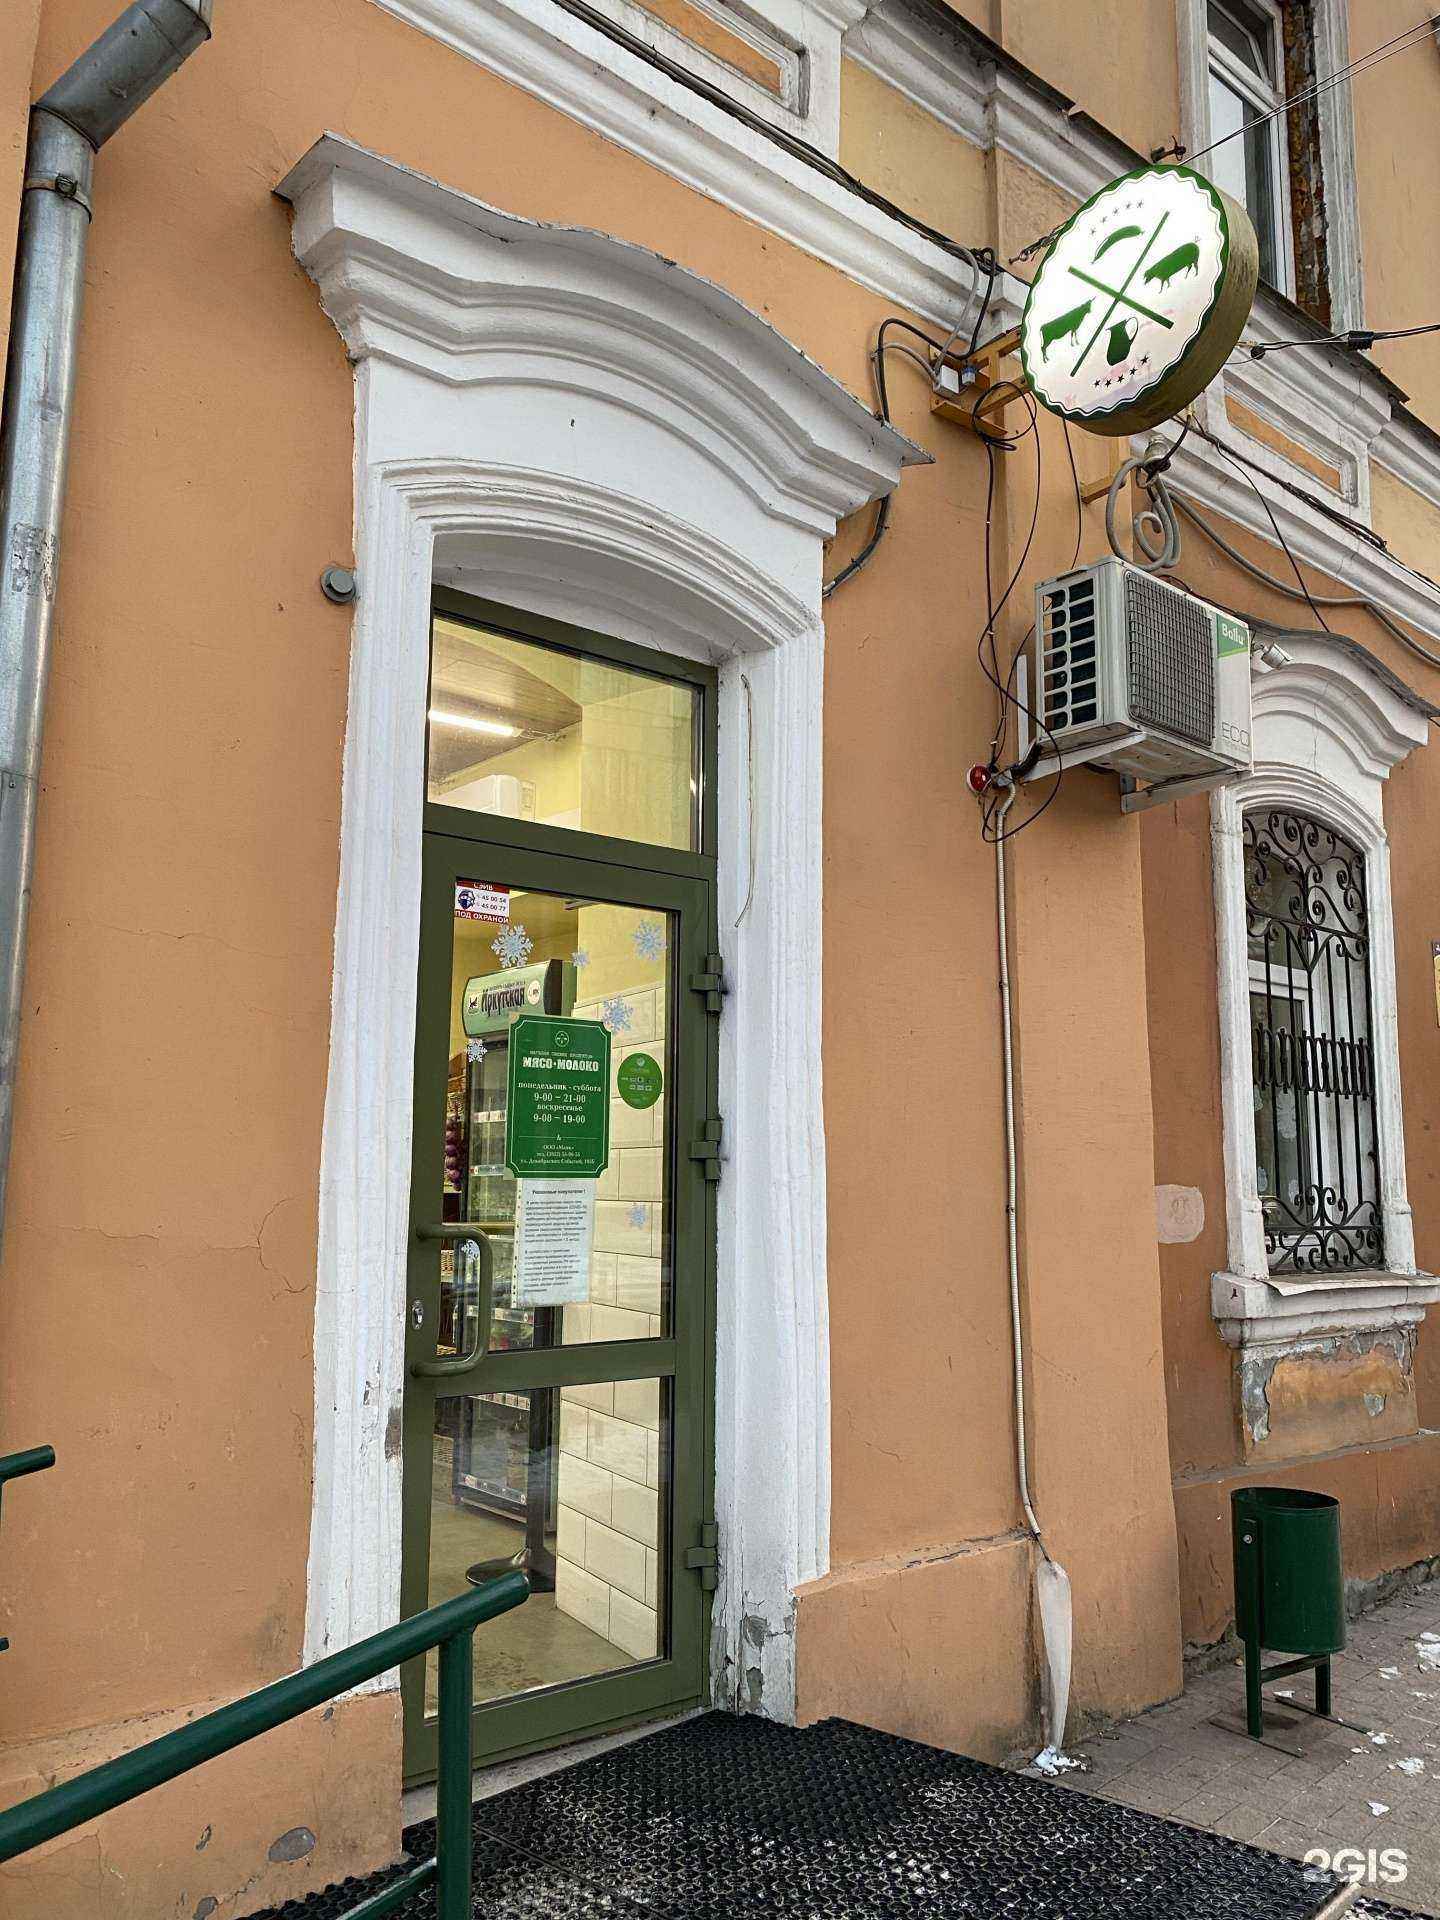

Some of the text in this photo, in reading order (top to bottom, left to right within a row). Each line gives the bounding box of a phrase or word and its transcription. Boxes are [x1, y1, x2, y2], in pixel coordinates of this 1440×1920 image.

[1221, 623, 1244, 645] Ballu
[1221, 721, 1250, 747] ECO
[455, 911, 471, 920] ПОД
[518, 1082, 567, 1092] понедельник
[573, 1084, 601, 1094] суббота
[534, 1092, 553, 1102] 9-00
[563, 1094, 586, 1104] 21-00
[537, 1104, 583, 1112] воскресенье
[533, 1113, 552, 1122] 9-00
[563, 1114, 586, 1124] 19-00
